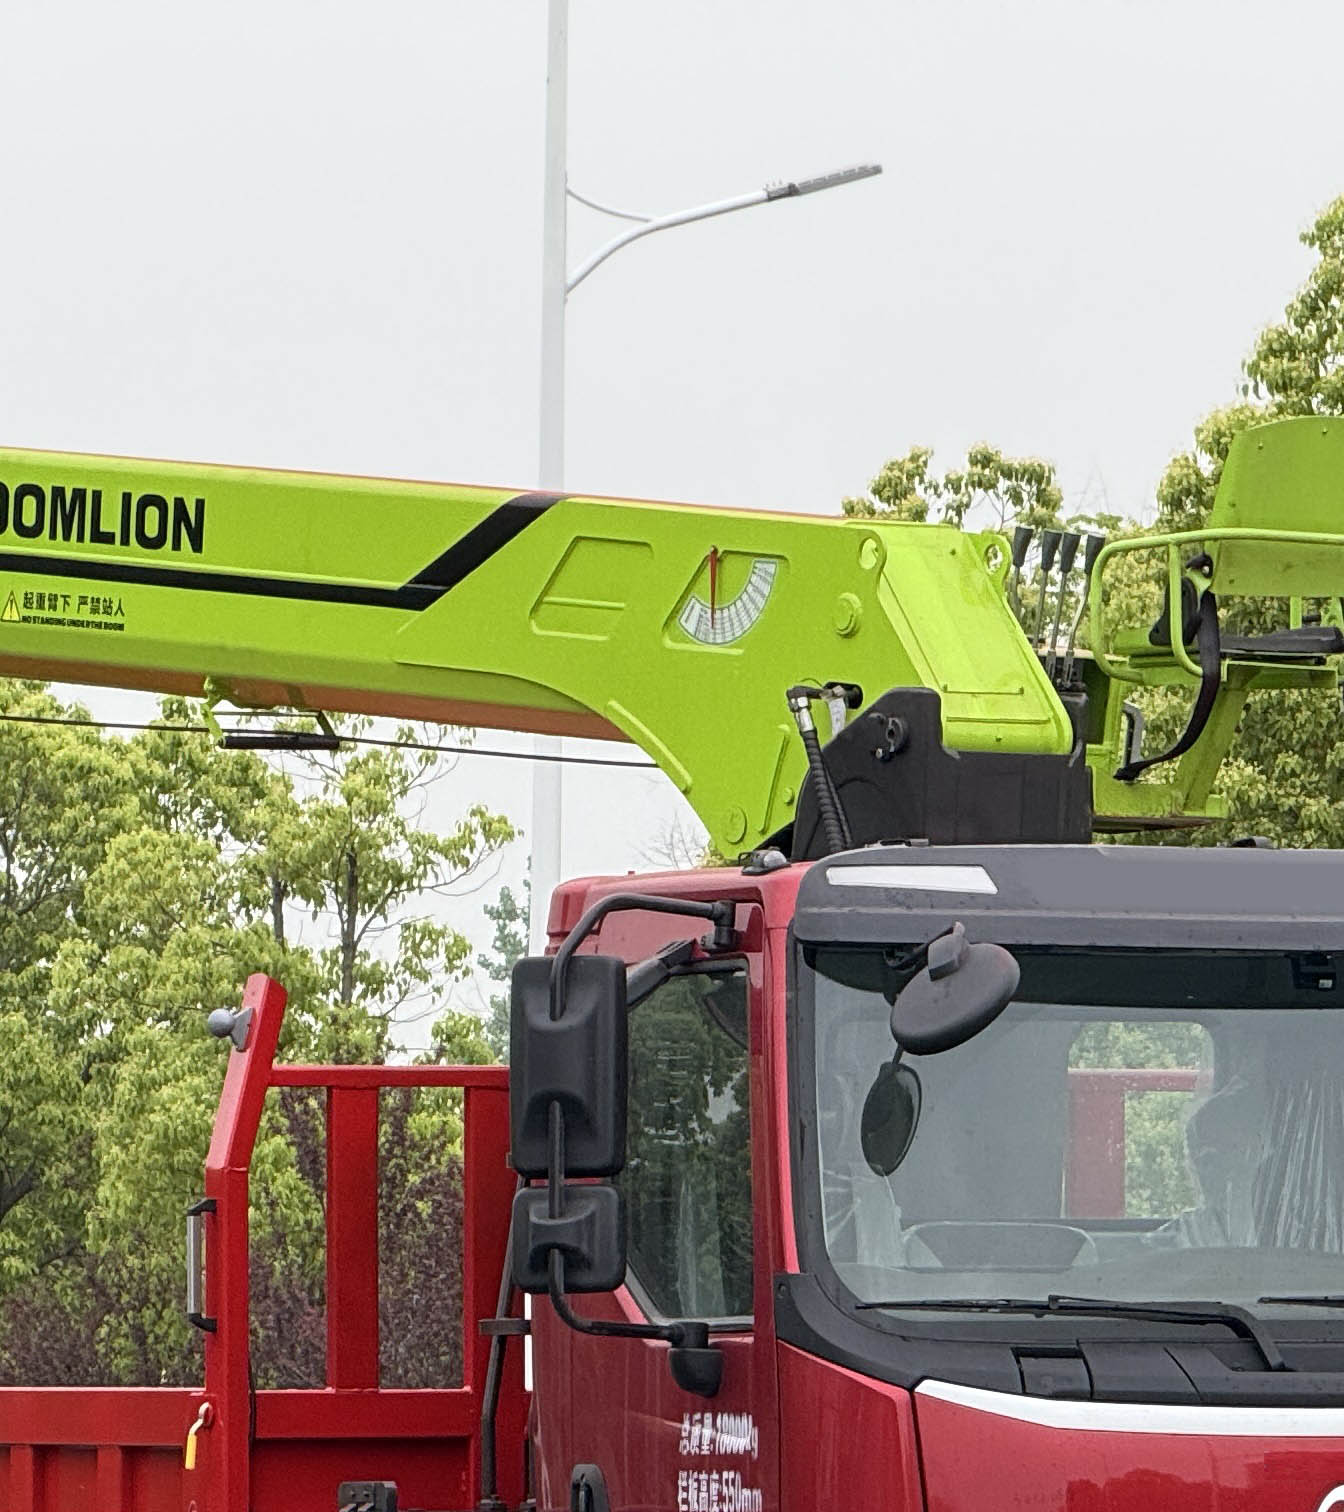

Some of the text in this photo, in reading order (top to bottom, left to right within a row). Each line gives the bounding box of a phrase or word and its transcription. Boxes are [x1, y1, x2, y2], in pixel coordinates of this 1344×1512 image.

[23, 590, 125, 617] 起重臂下 严禁站人
